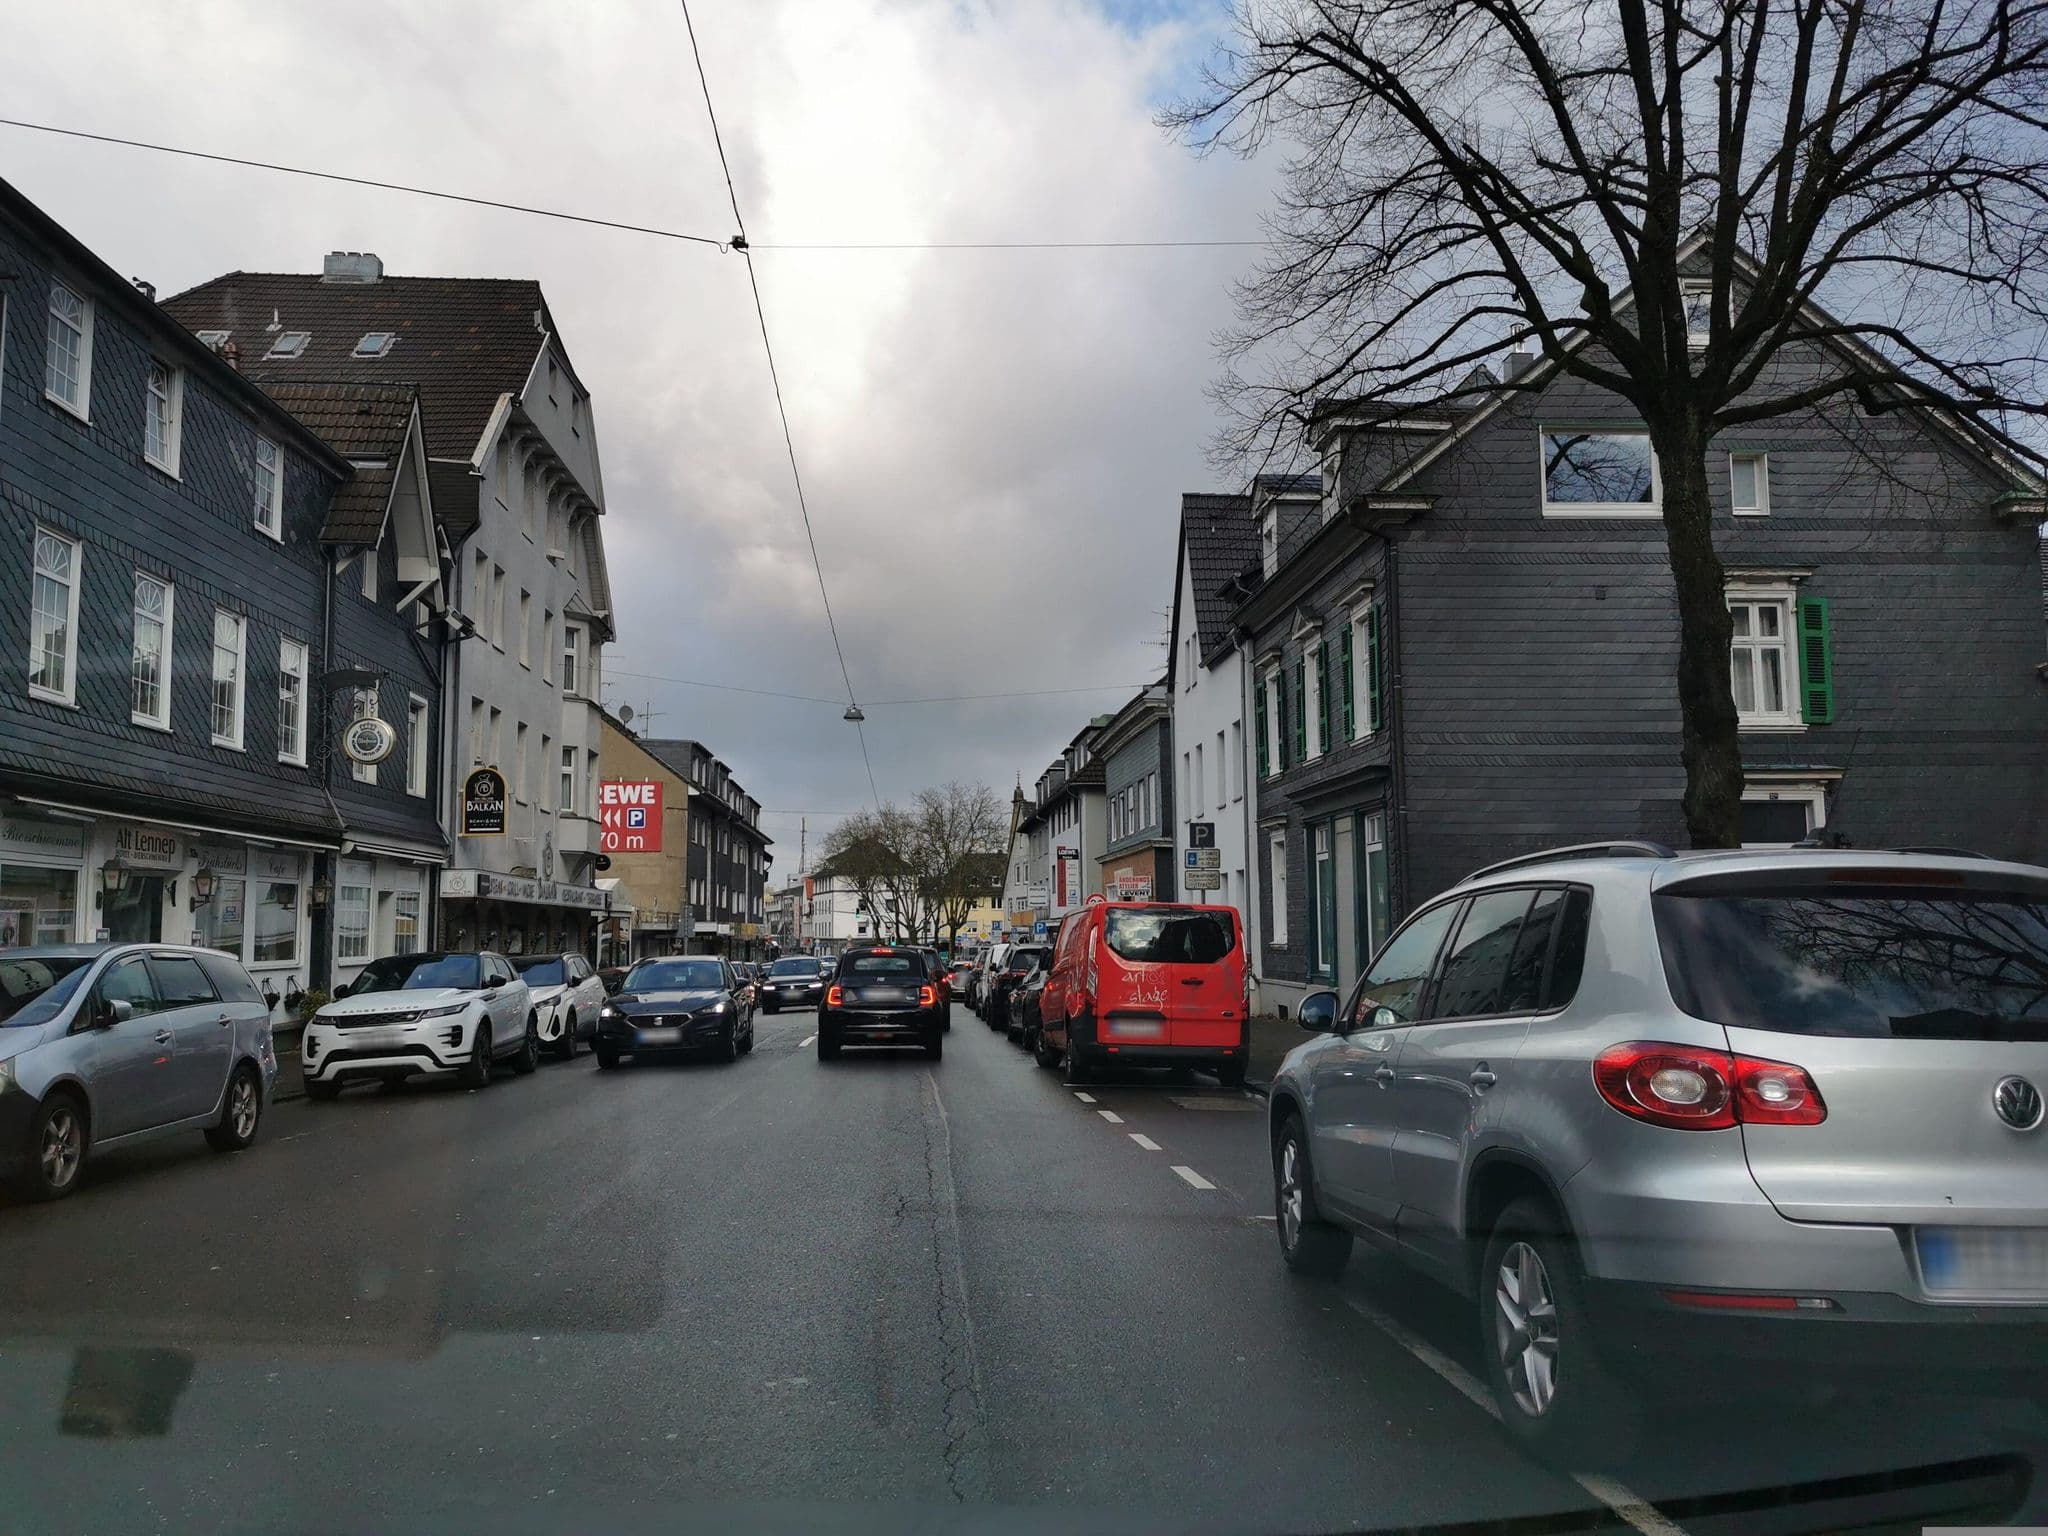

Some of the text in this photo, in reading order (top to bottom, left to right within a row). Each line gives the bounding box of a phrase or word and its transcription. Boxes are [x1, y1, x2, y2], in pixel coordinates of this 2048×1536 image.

[466, 800, 504, 811] BALKAN
[629, 810, 643, 826] P
[626, 835, 644, 849] m
[1195, 825, 1209, 846] P
[116, 827, 176, 863] Alt Lennep
[1036, 923, 1045, 934] P
